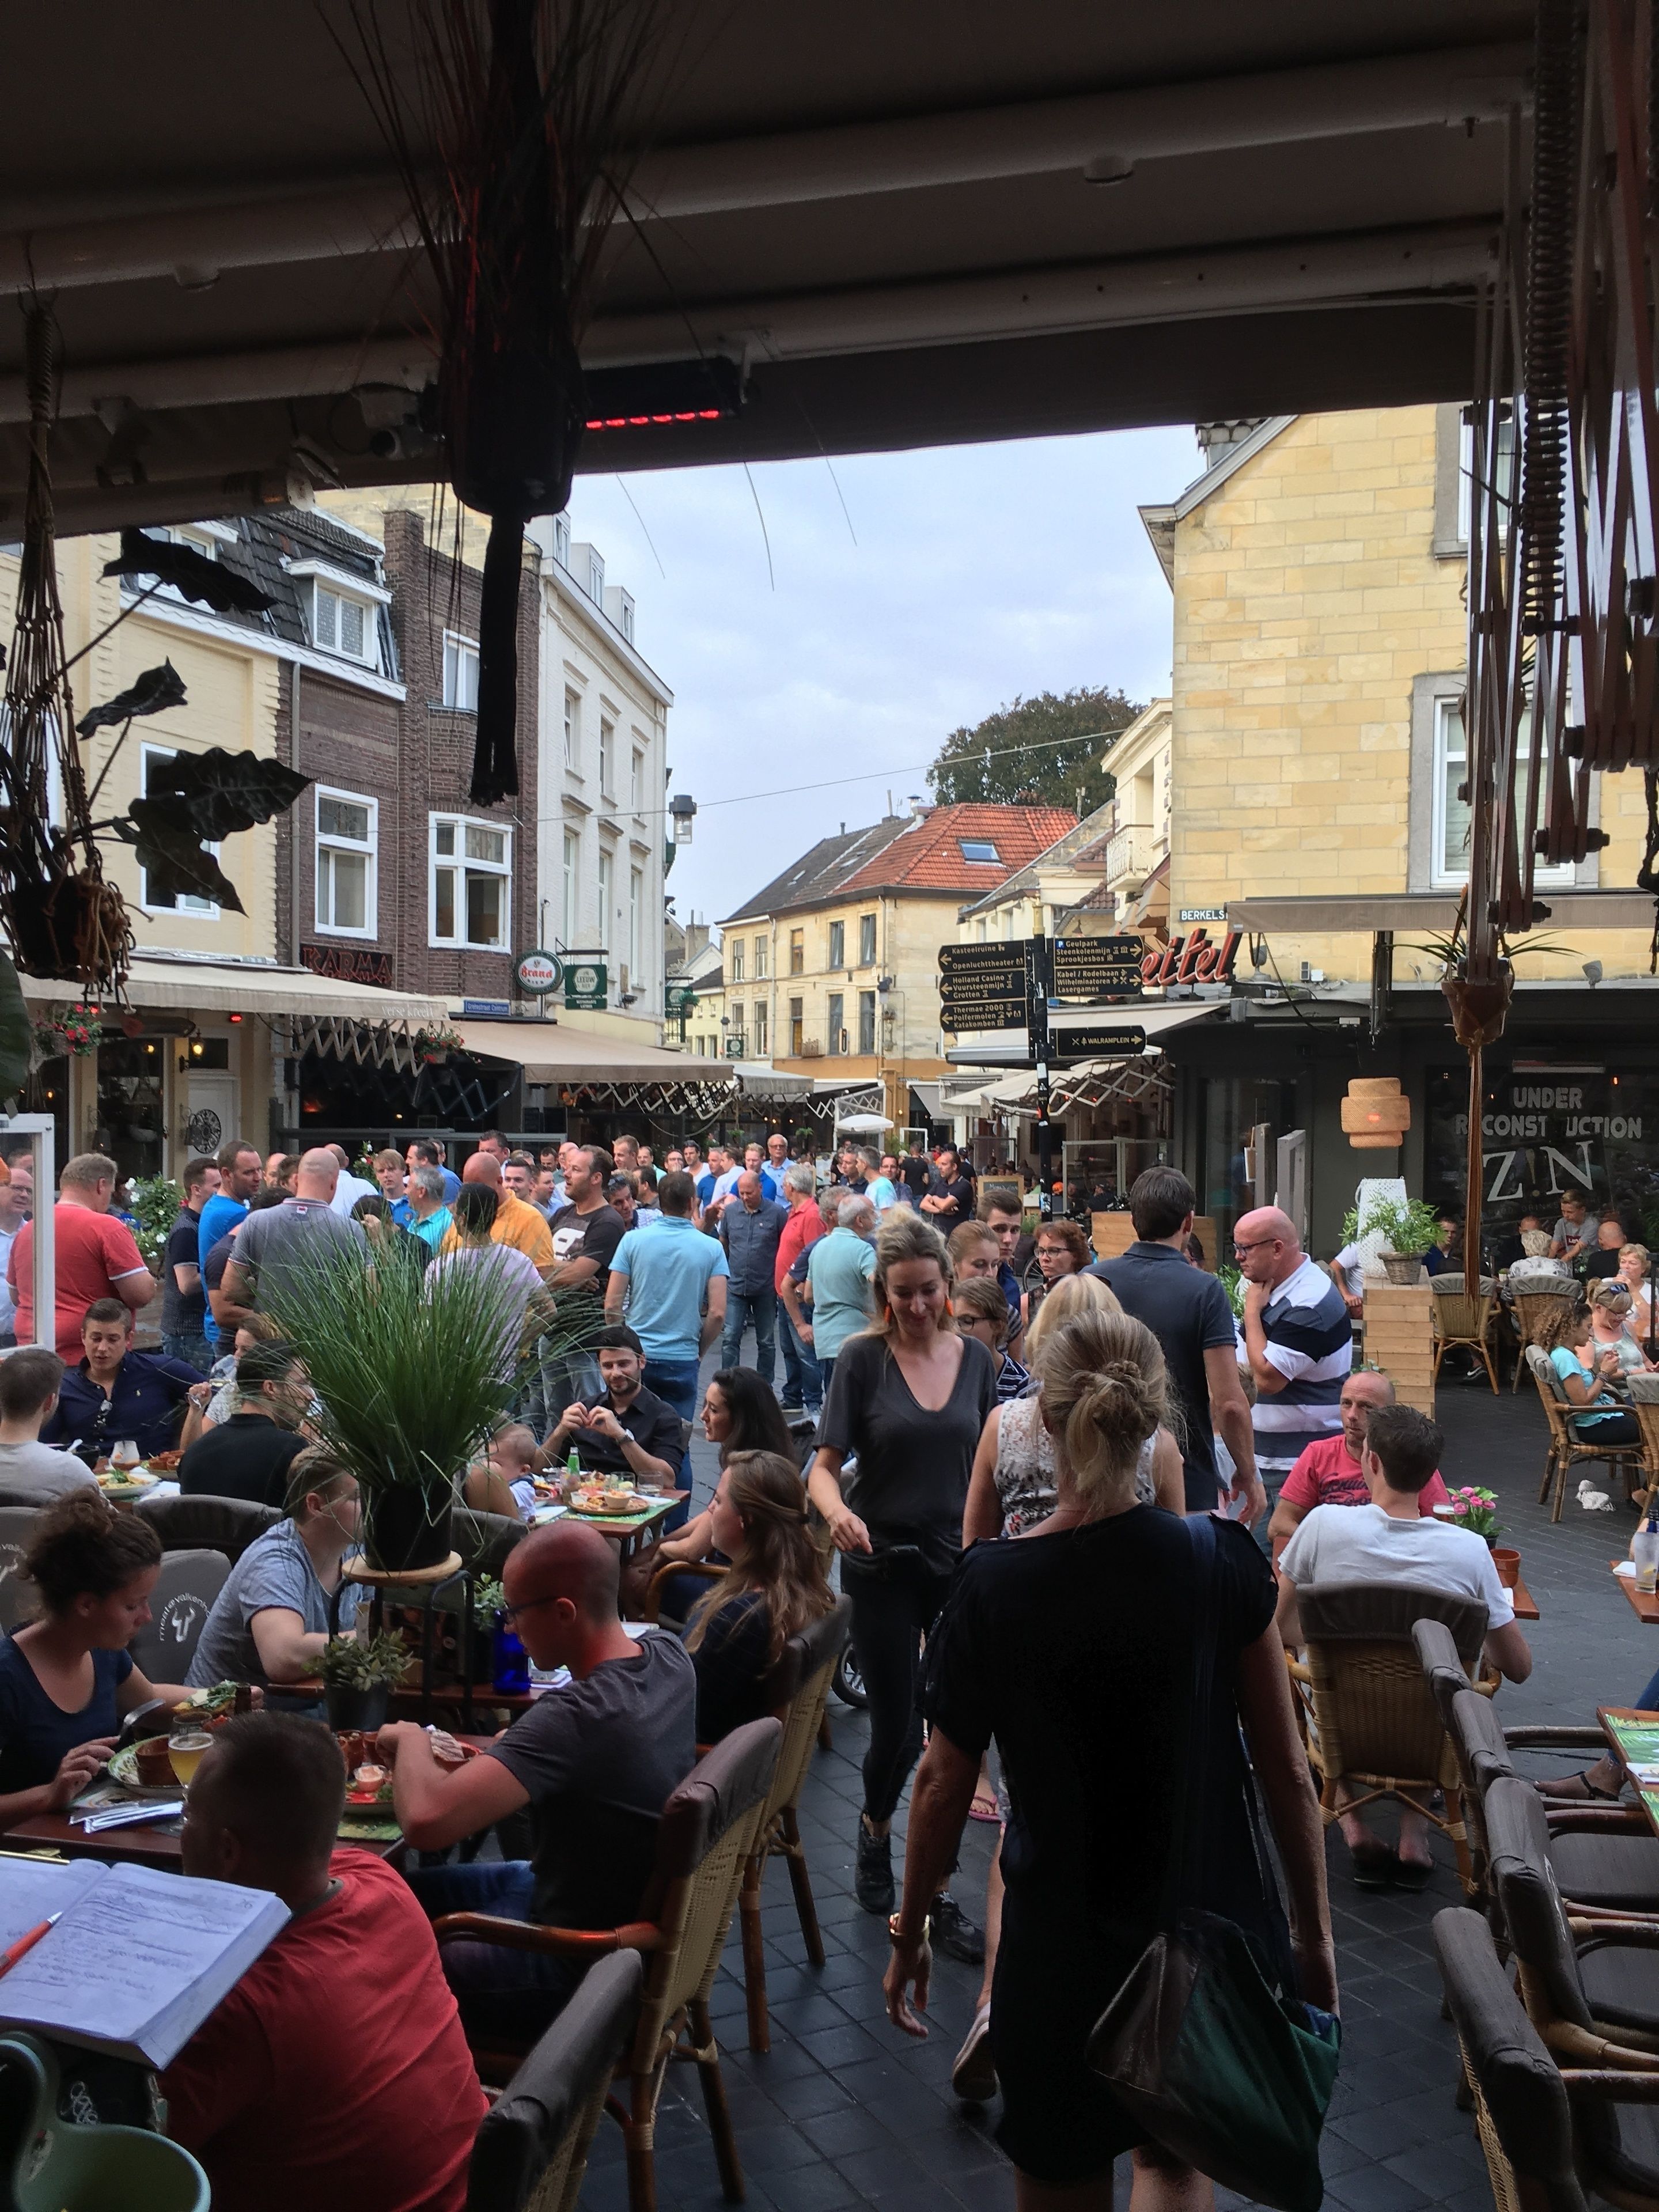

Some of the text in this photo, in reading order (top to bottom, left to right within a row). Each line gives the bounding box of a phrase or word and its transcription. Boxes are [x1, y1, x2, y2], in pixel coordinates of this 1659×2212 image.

[1056, 947, 1110, 955] Steenkolenmijn
[1056, 956, 1104, 964] Sprookjesbos
[1141, 927, 1237, 987] eitel
[303, 947, 392, 984] KARMA
[952, 960, 1014, 970] Openluchttheater
[521, 965, 552, 978] Brand
[953, 976, 980, 984] Holland
[953, 982, 1005, 991] Vuursteenmijn
[1058, 986, 1099, 994] Lasergames
[953, 1013, 996, 1021] Polfermolen
[954, 1020, 995, 1028] Katakomben
[1513, 1087, 1582, 1109] UNDER
